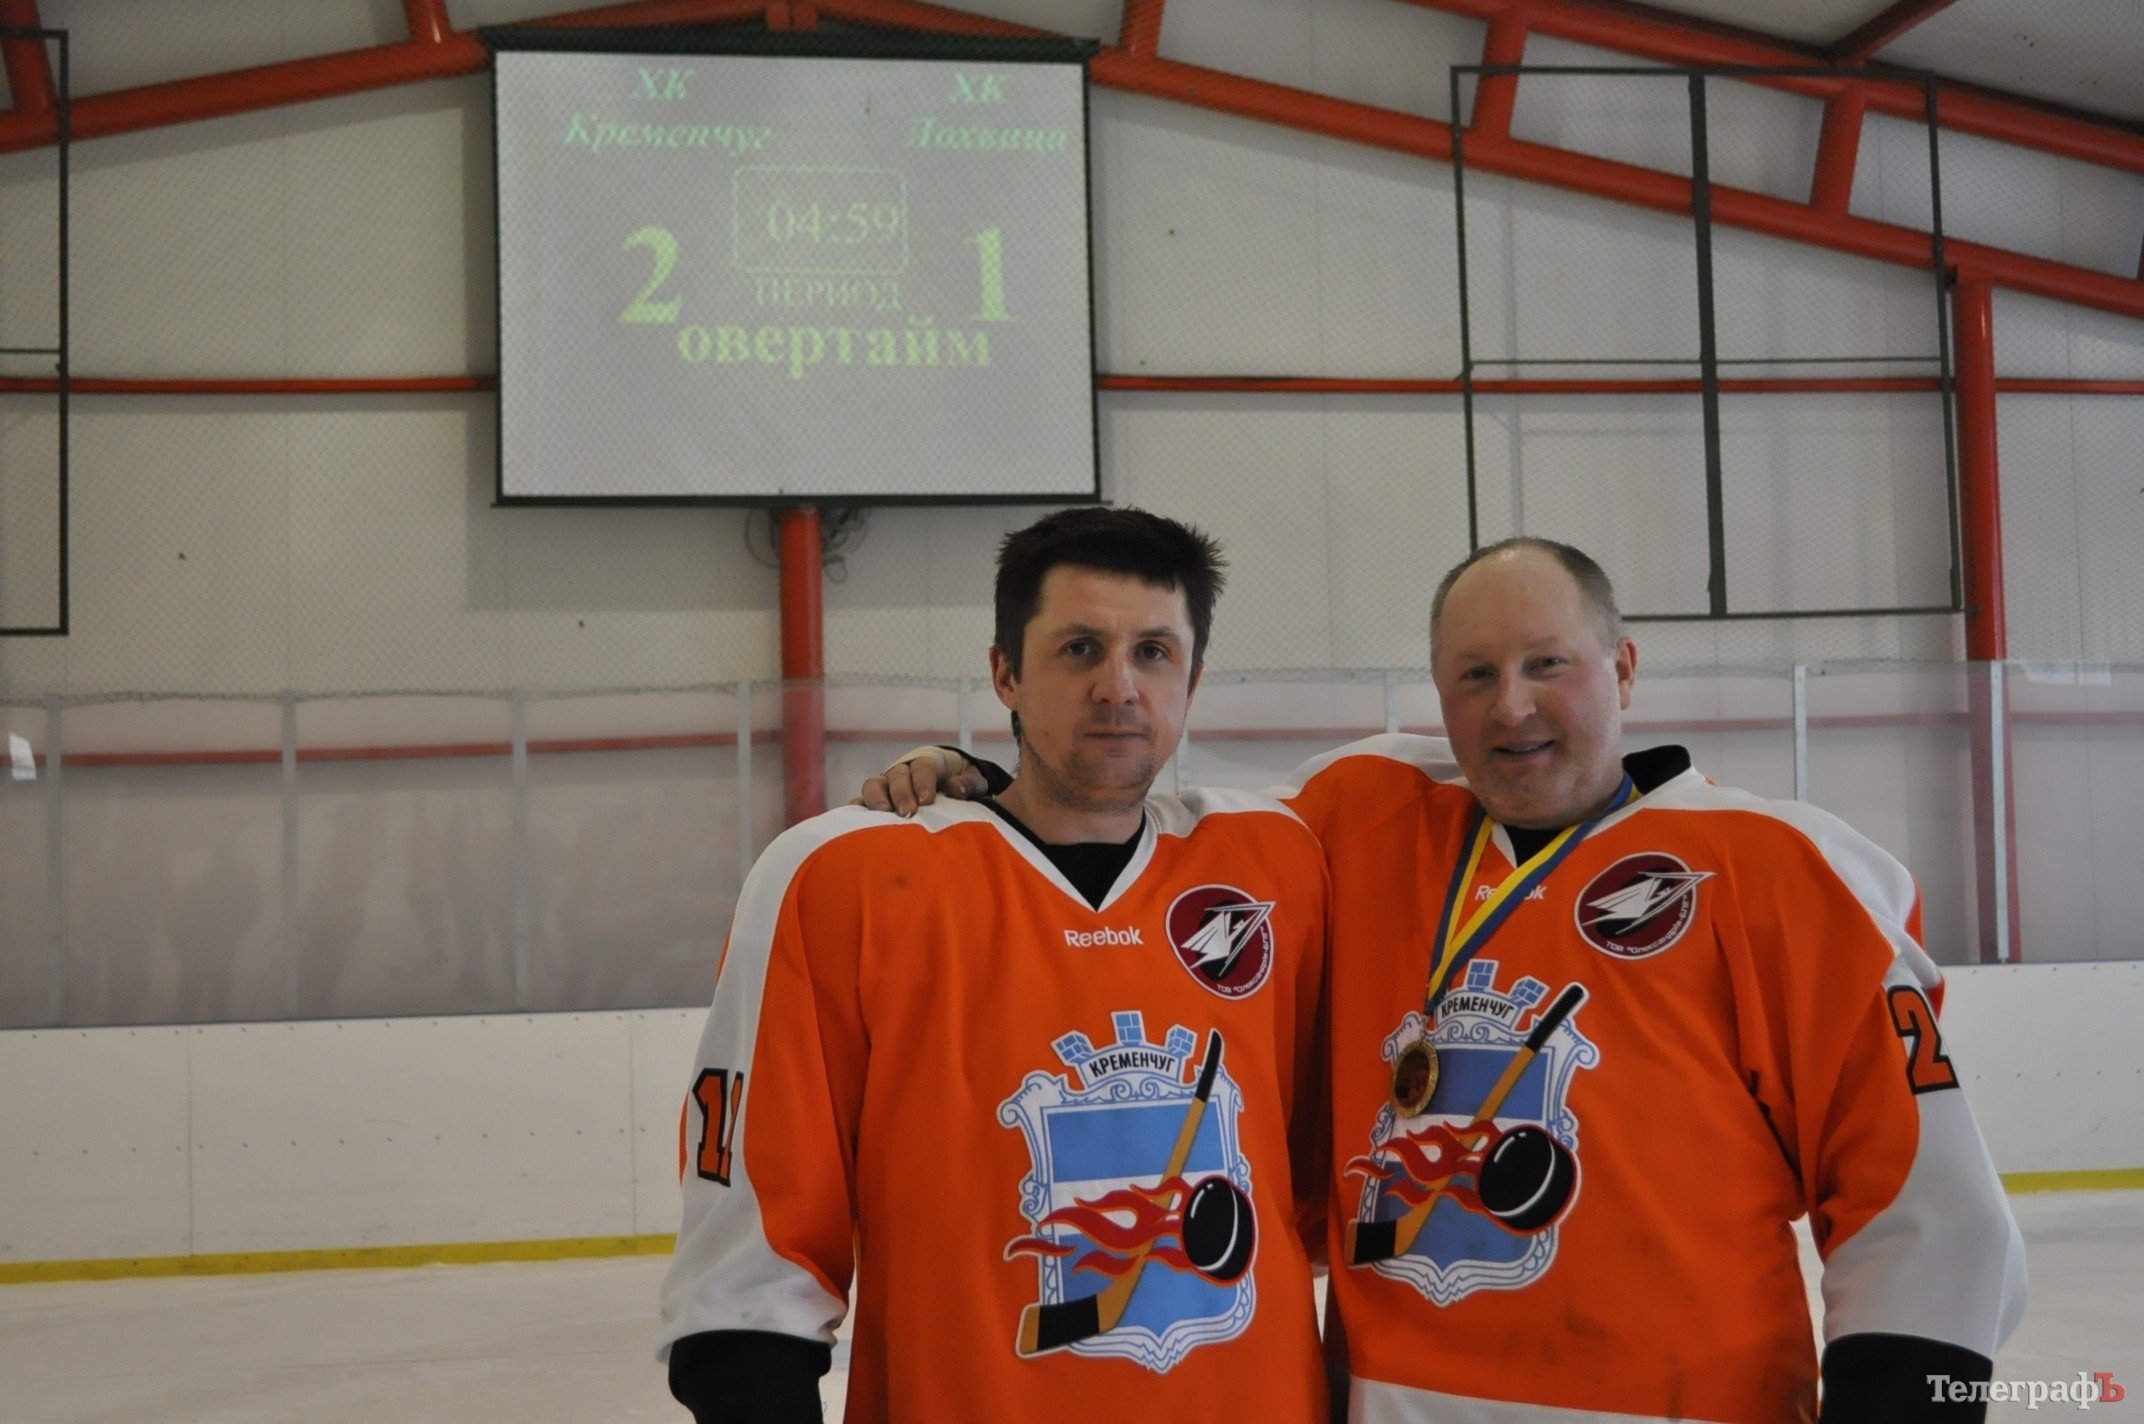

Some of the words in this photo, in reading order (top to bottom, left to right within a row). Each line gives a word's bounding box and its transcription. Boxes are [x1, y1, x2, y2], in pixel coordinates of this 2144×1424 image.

[631, 67, 697, 99] ХК
[950, 74, 1013, 103] ХК
[564, 112, 772, 157] Кременчуг
[767, 202, 900, 244] 04:59
[617, 225, 682, 324] 2
[964, 226, 1017, 323] 1
[677, 314, 992, 380] овертайм
[1063, 925, 1144, 948] Reebok
[1440, 996, 1515, 1019] КРЕМЕНЧУГ
[1088, 1051, 1176, 1078] КРЕМЕНЧУГ
